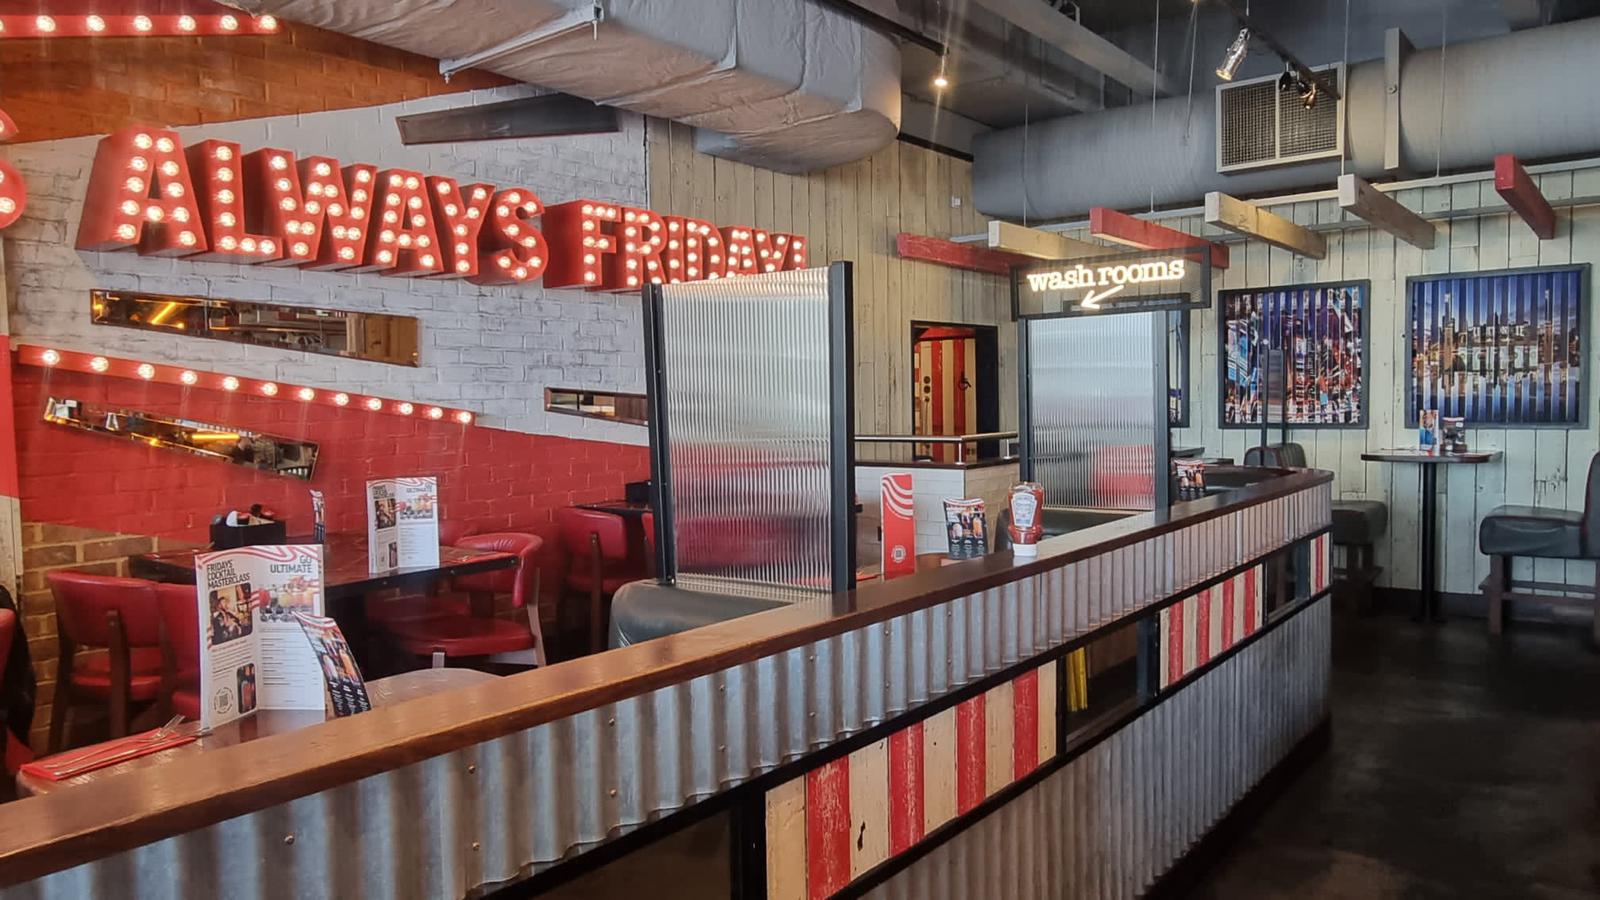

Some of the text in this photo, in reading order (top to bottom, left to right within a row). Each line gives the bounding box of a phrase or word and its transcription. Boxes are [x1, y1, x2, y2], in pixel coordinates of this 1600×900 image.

[77, 125, 548, 285] ALWAYS
[1027, 259, 1185, 292] wash rooms
[300, 555, 312, 564] GO
[207, 568, 236, 581] COCKTAIL
[270, 564, 312, 573] ULTIMATE
[208, 572, 250, 589] MASTERCLASS
